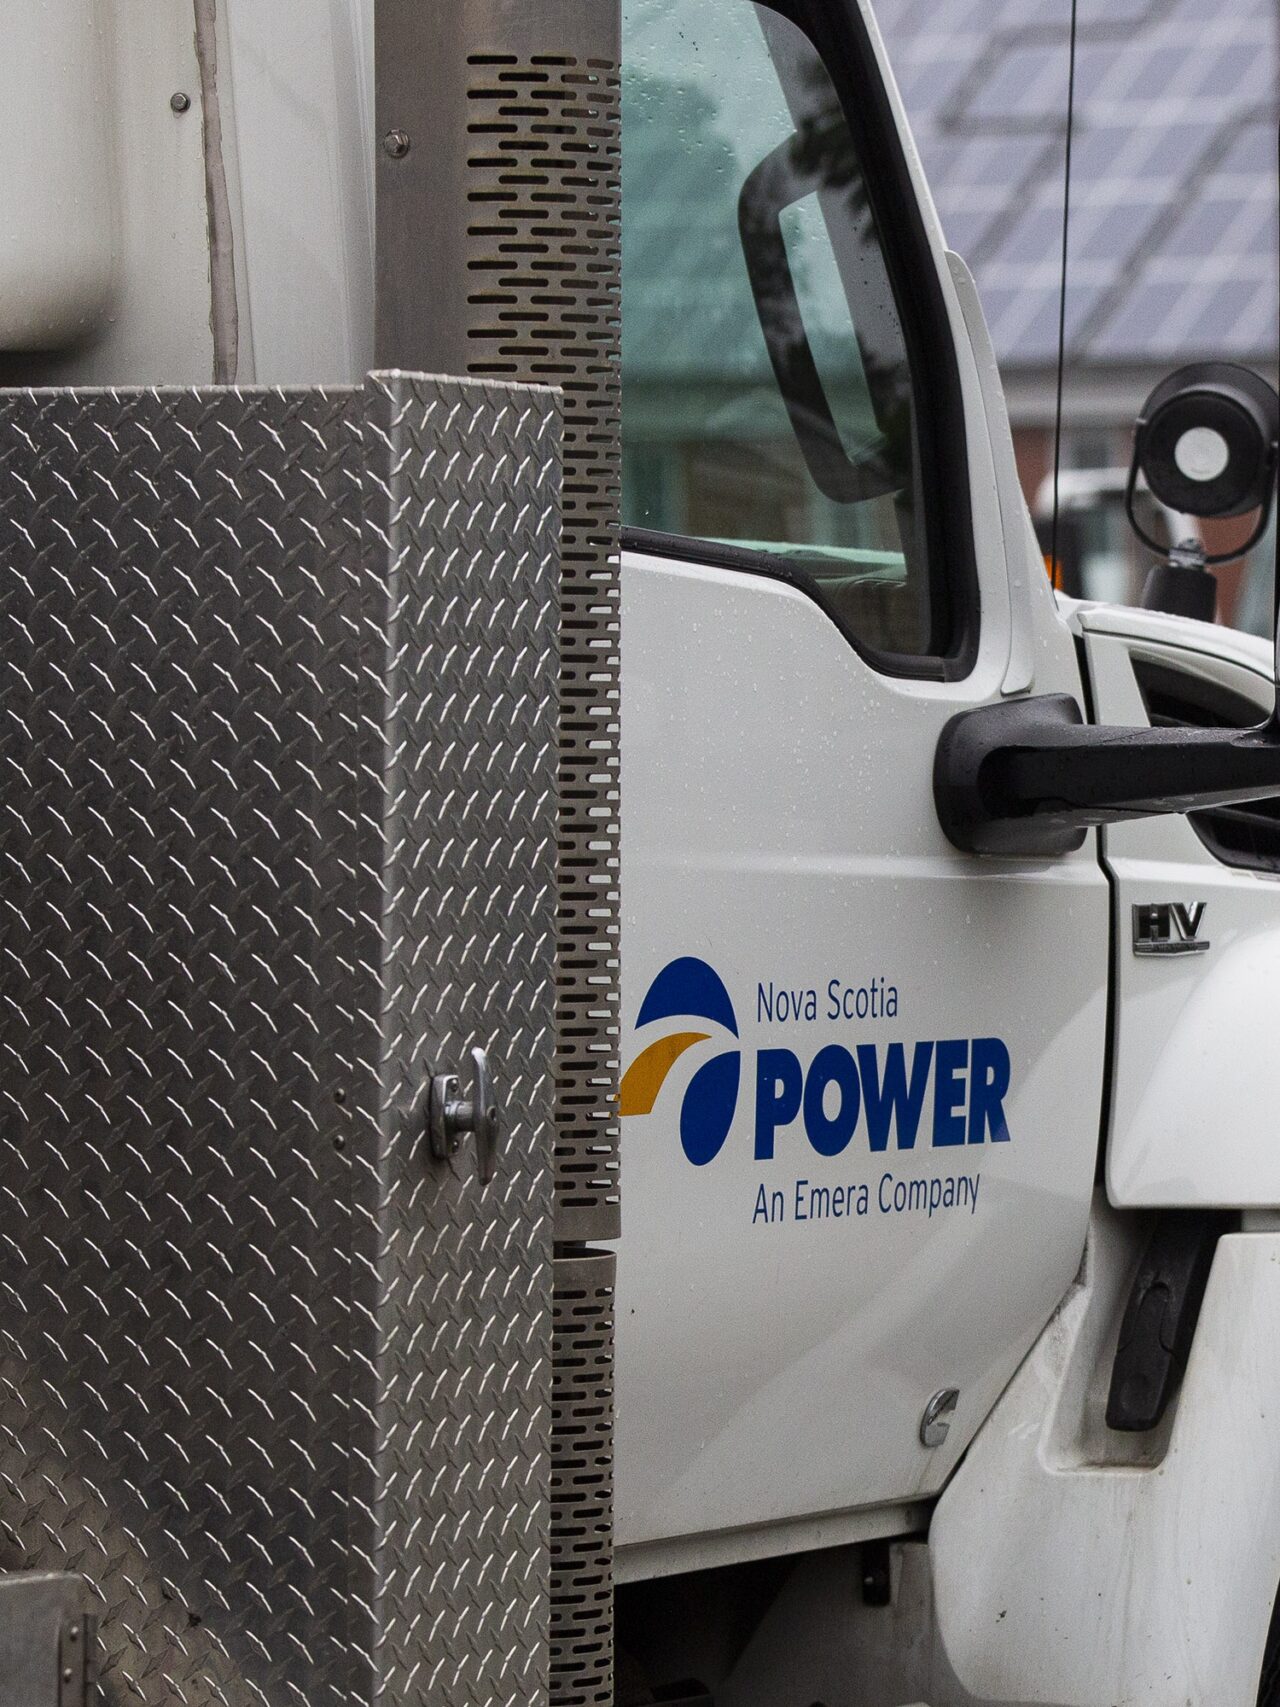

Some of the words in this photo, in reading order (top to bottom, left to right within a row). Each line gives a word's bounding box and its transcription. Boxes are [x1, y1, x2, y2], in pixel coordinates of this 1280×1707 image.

[1132, 902, 1207, 942] HV
[757, 982, 817, 1023] Nova
[827, 977, 898, 1020] Scotia
[754, 1037, 1011, 1160] POWER
[752, 1183, 784, 1224] An
[794, 1179, 868, 1221] Emera
[878, 1172, 980, 1218] Company
